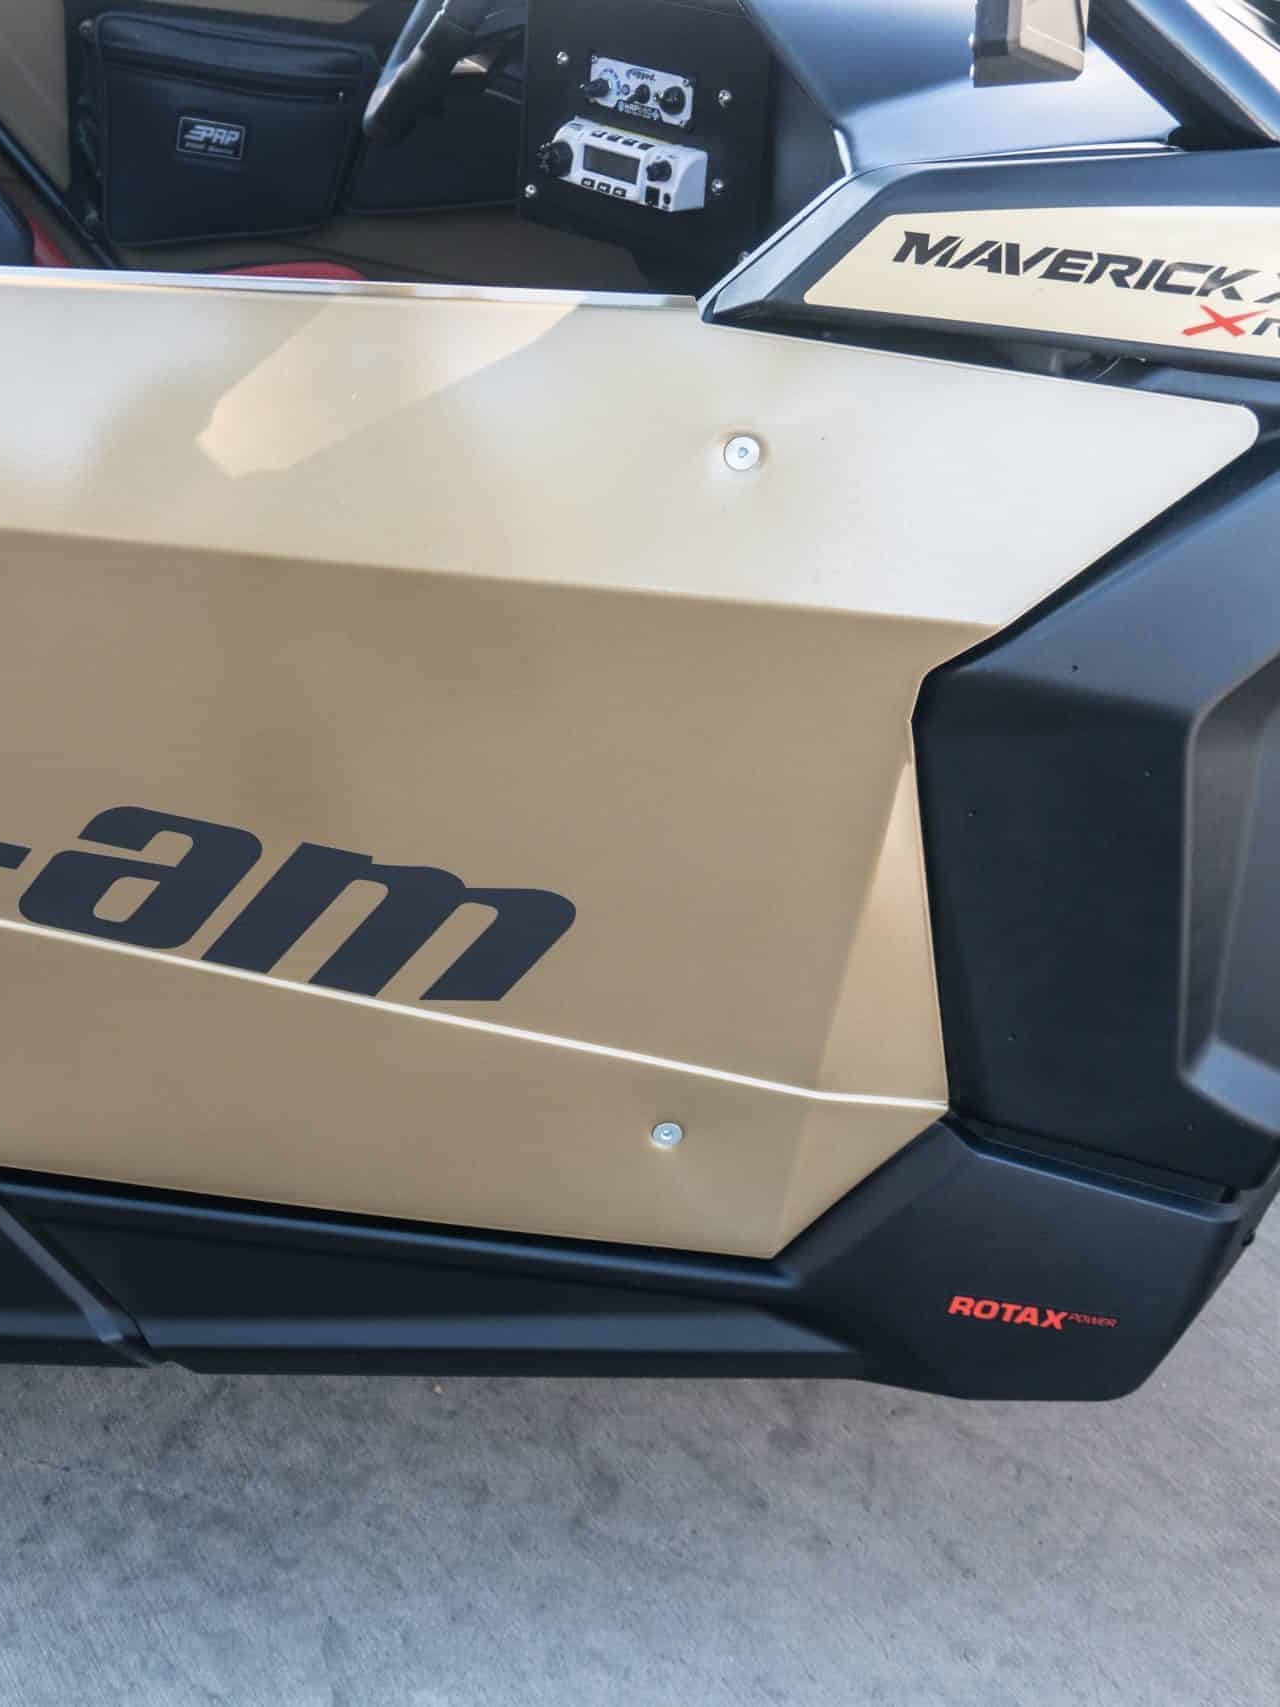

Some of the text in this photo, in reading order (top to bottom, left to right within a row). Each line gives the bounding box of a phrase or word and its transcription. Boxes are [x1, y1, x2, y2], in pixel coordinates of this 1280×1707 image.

[892, 231, 1262, 301] MAVERICK
[948, 1295, 1119, 1330] ROTAX POWER
